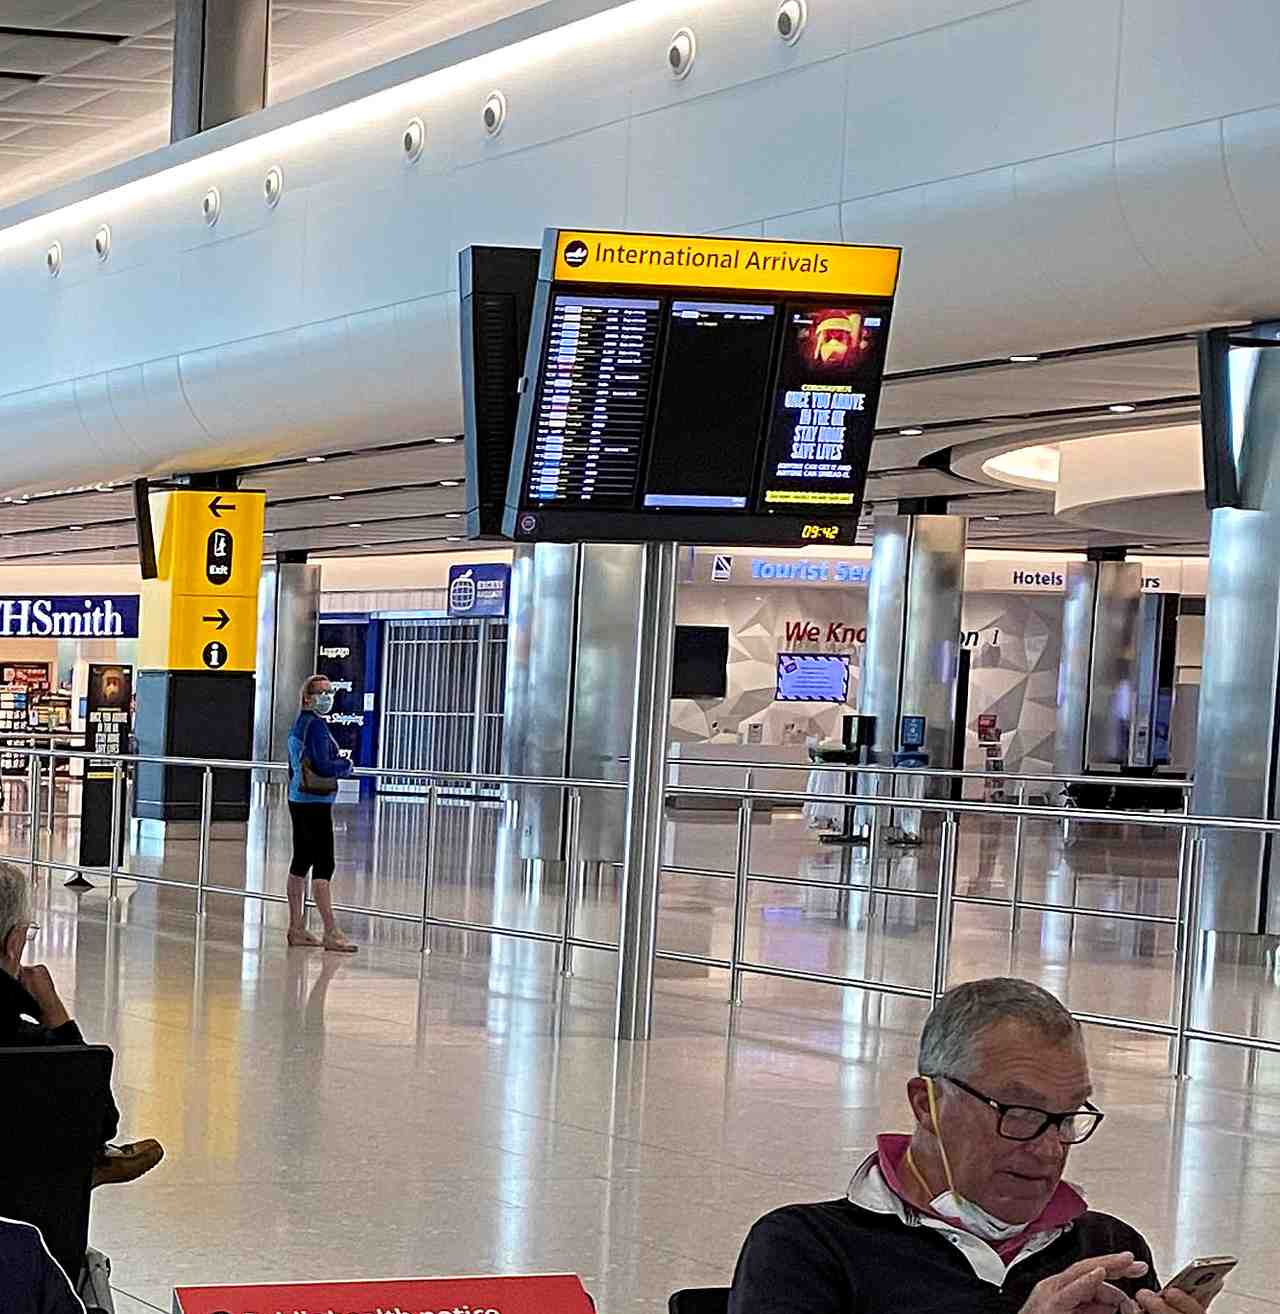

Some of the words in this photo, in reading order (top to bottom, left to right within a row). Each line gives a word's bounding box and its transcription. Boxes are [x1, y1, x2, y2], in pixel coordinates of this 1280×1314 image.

[595, 241, 741, 271] International
[746, 252, 830, 275] Arrivals
[801, 525, 839, 540] 09:42
[209, 564, 228, 575] Exit
[752, 559, 829, 581] Tourist
[1013, 571, 1063, 586] Hotels
[785, 621, 820, 643] We
